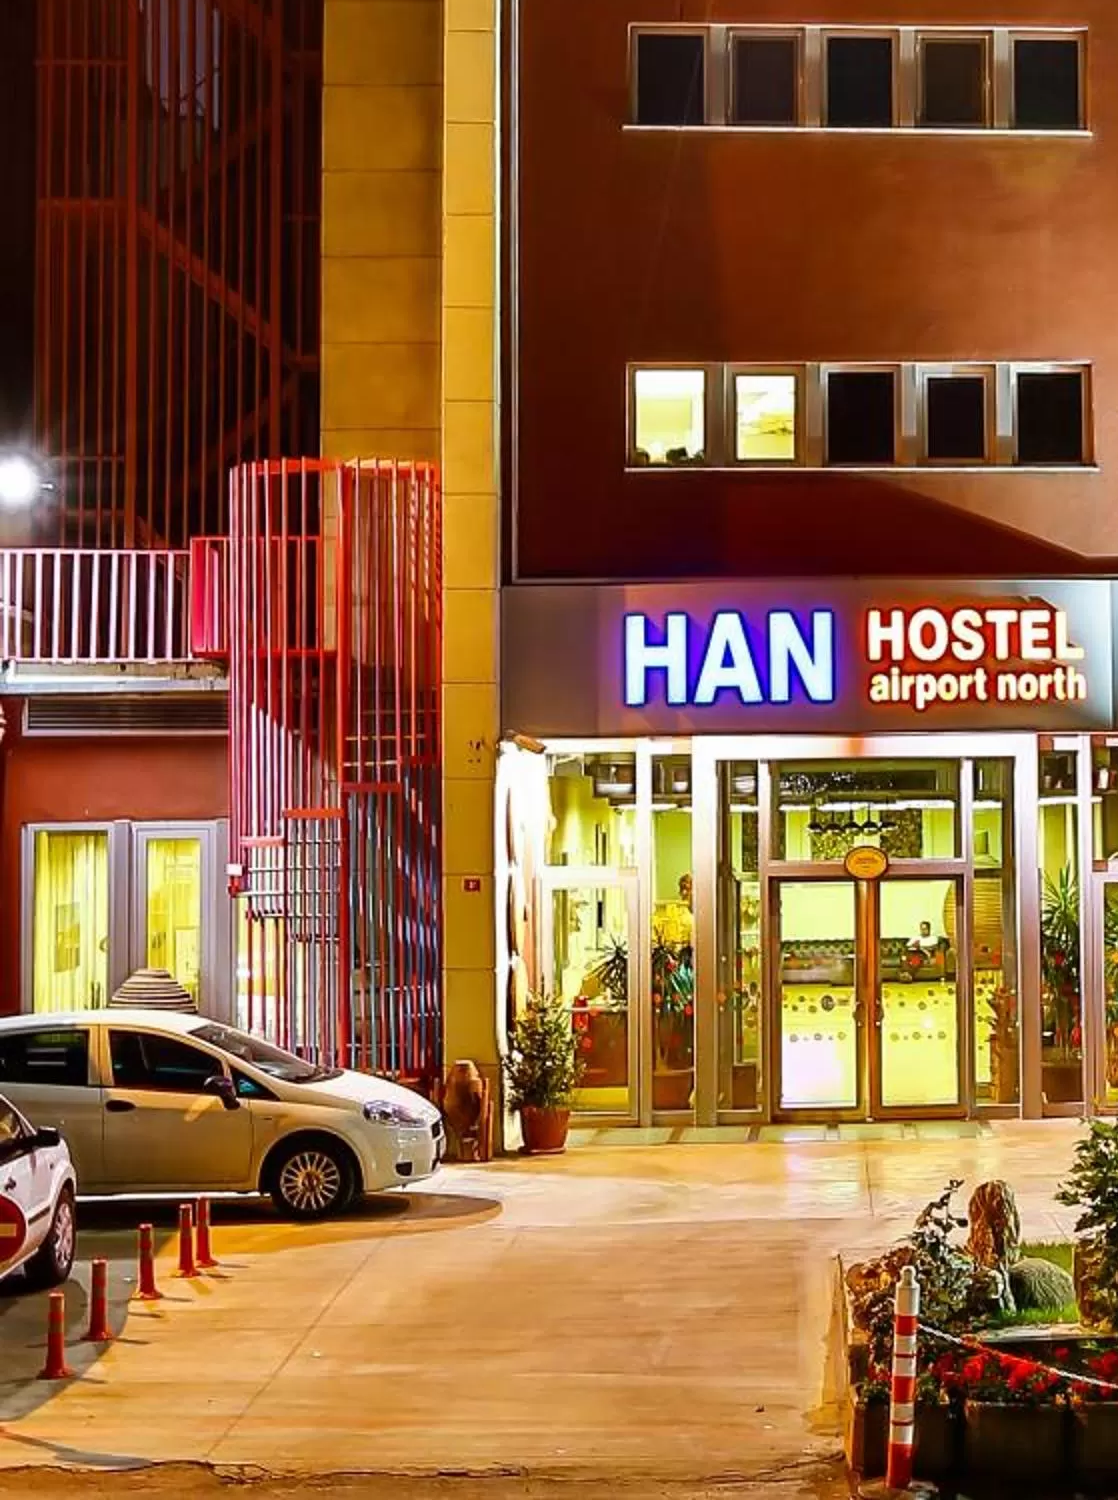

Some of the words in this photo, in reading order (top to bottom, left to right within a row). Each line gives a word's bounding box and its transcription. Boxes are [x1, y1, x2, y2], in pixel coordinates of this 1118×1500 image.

[625, 610, 834, 706] HAN
[867, 607, 1086, 662] HOSTEL
[869, 666, 988, 711] airport
[996, 665, 1088, 701] north
